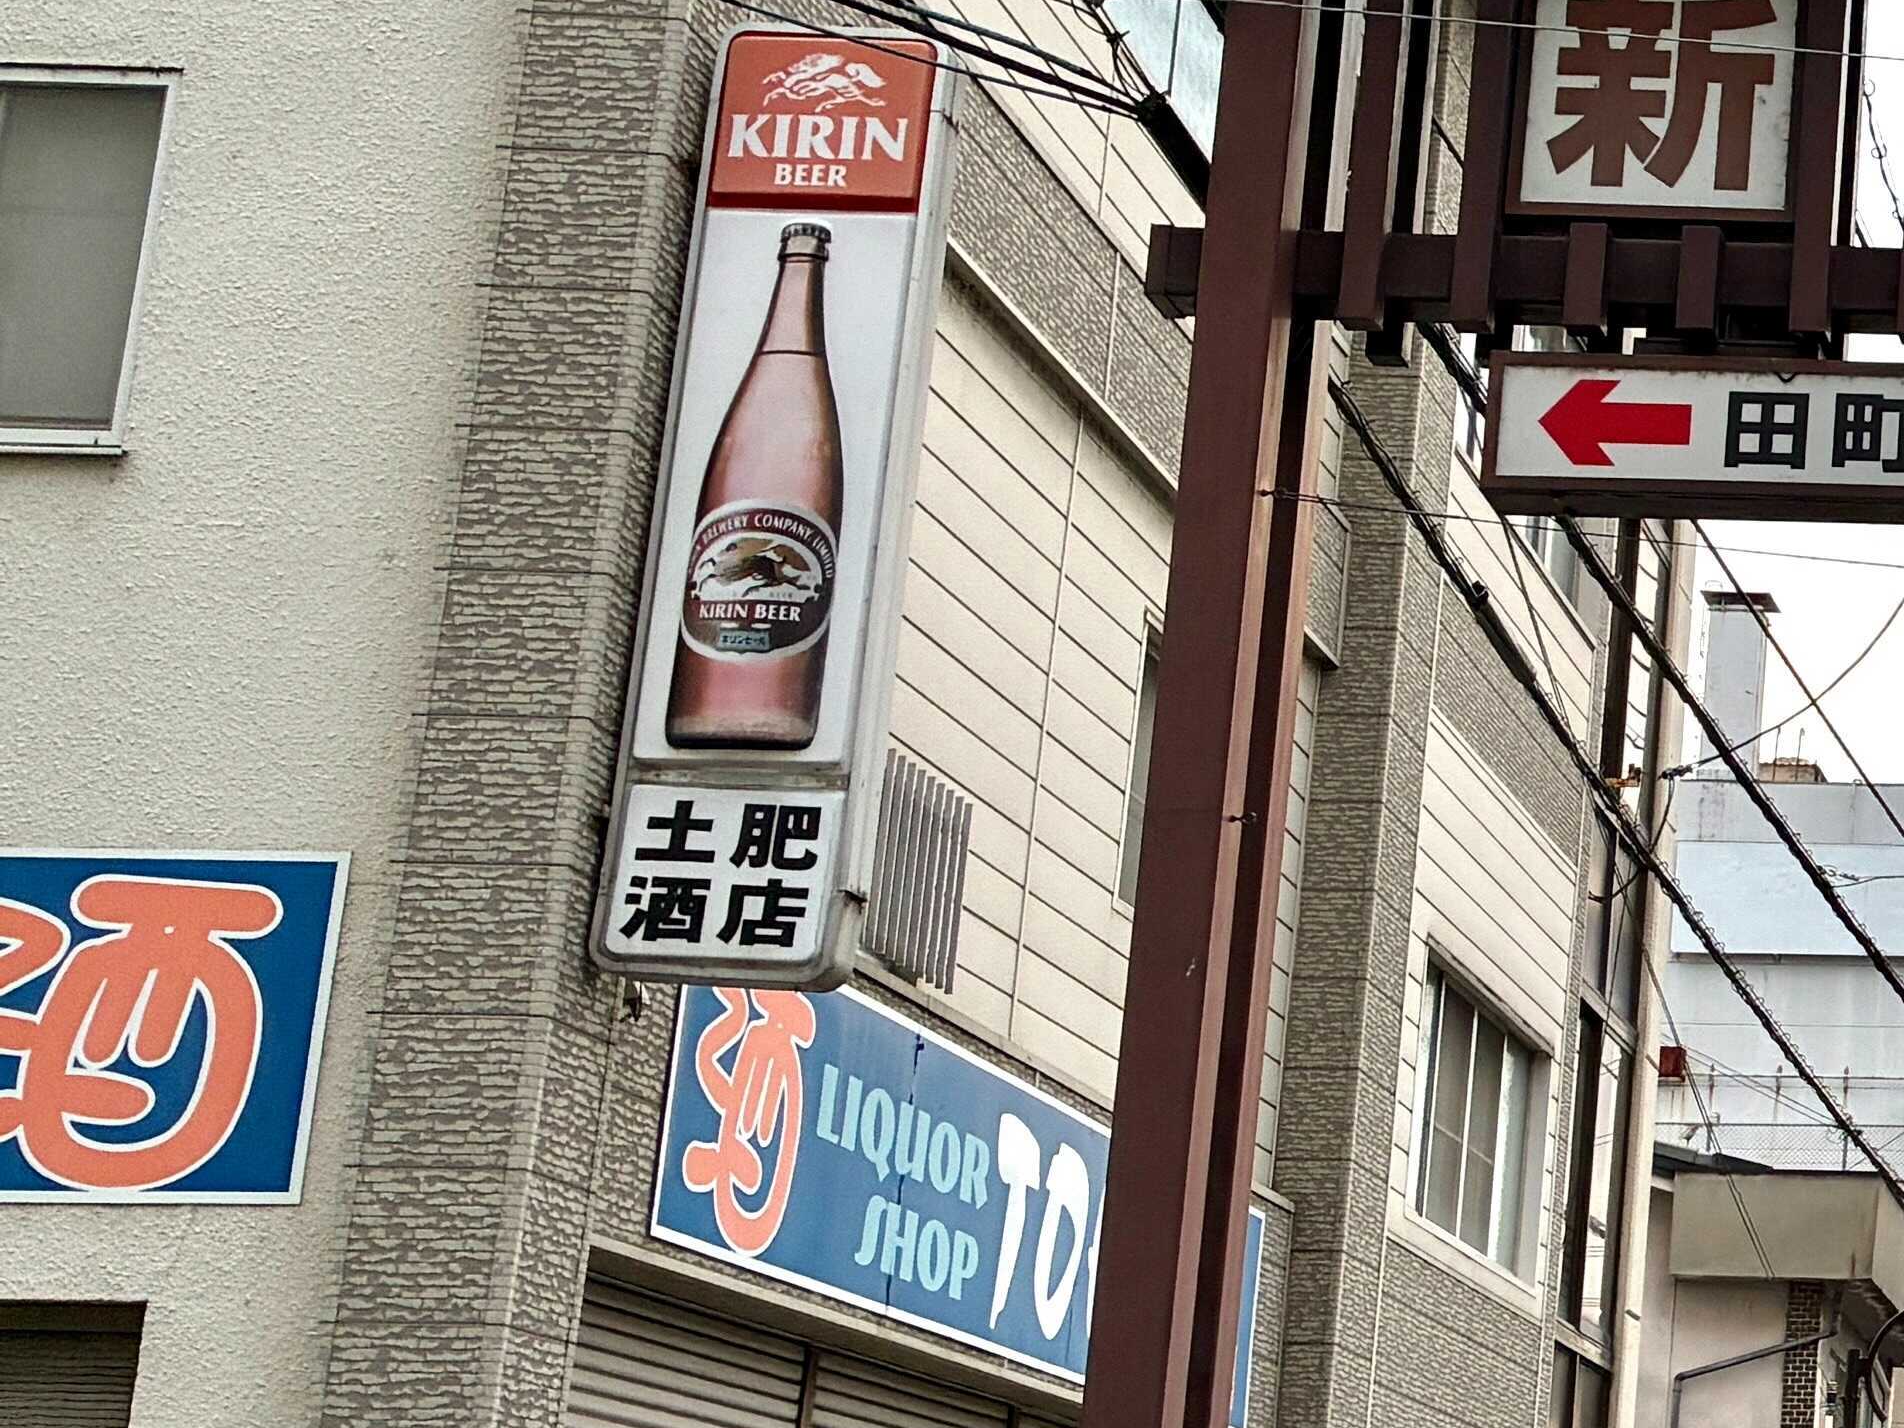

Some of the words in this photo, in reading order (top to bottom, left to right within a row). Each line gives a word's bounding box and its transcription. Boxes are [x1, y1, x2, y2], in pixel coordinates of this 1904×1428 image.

[727, 112, 909, 166] KIRIN
[774, 162, 848, 190] BEER
[699, 603, 748, 620] KIRIN
[754, 604, 801, 622] BEER
[636, 800, 821, 870] 土肥
[620, 877, 813, 948] 酒店
[816, 1063, 991, 1210] LIQUOR
[855, 1194, 980, 1300] SHOP
